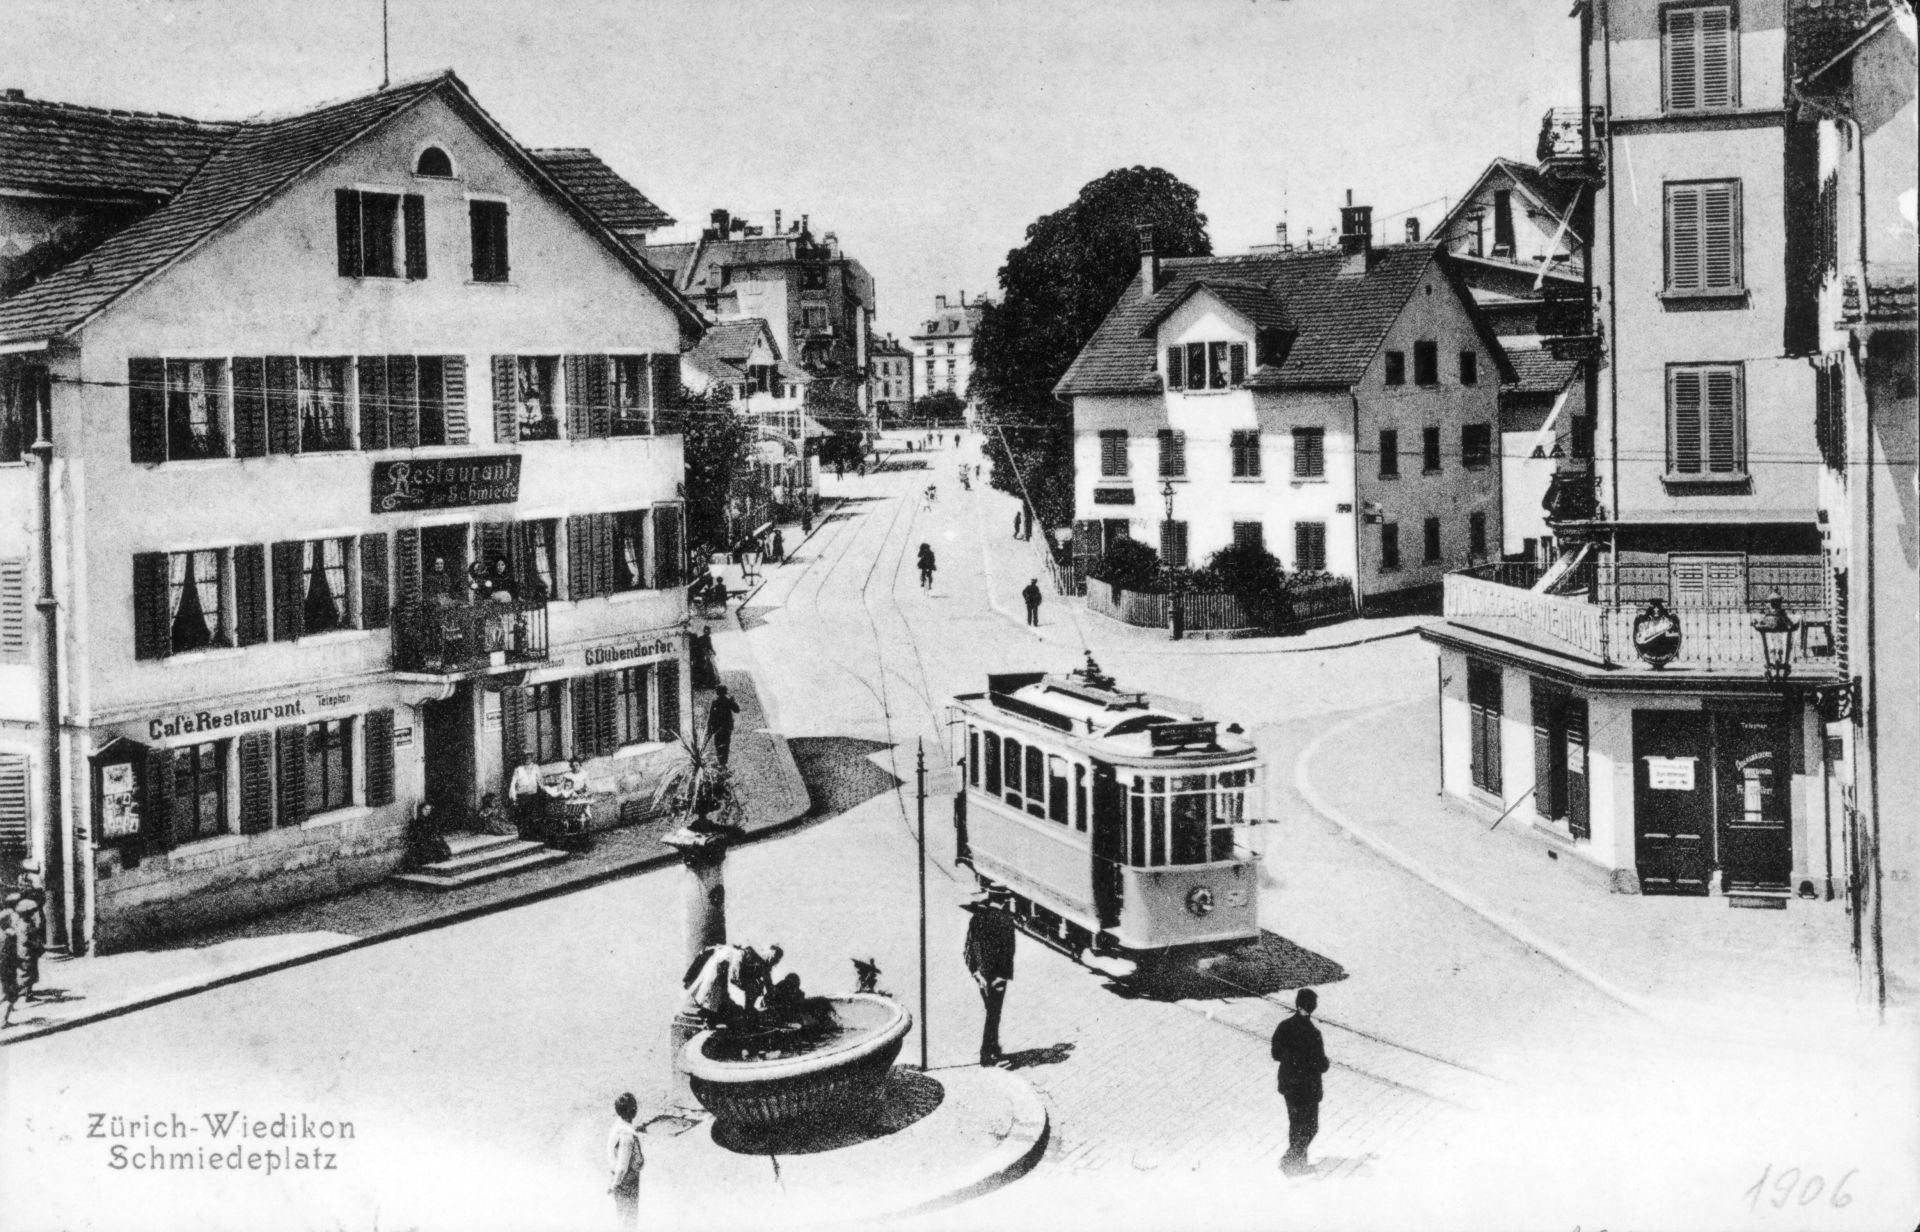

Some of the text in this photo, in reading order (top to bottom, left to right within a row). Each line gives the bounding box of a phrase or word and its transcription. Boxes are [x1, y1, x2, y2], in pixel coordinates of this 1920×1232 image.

[387, 457, 512, 498] Restaurant
[149, 715, 194, 740] Café
[1742, 1163, 1860, 1211] 1906
